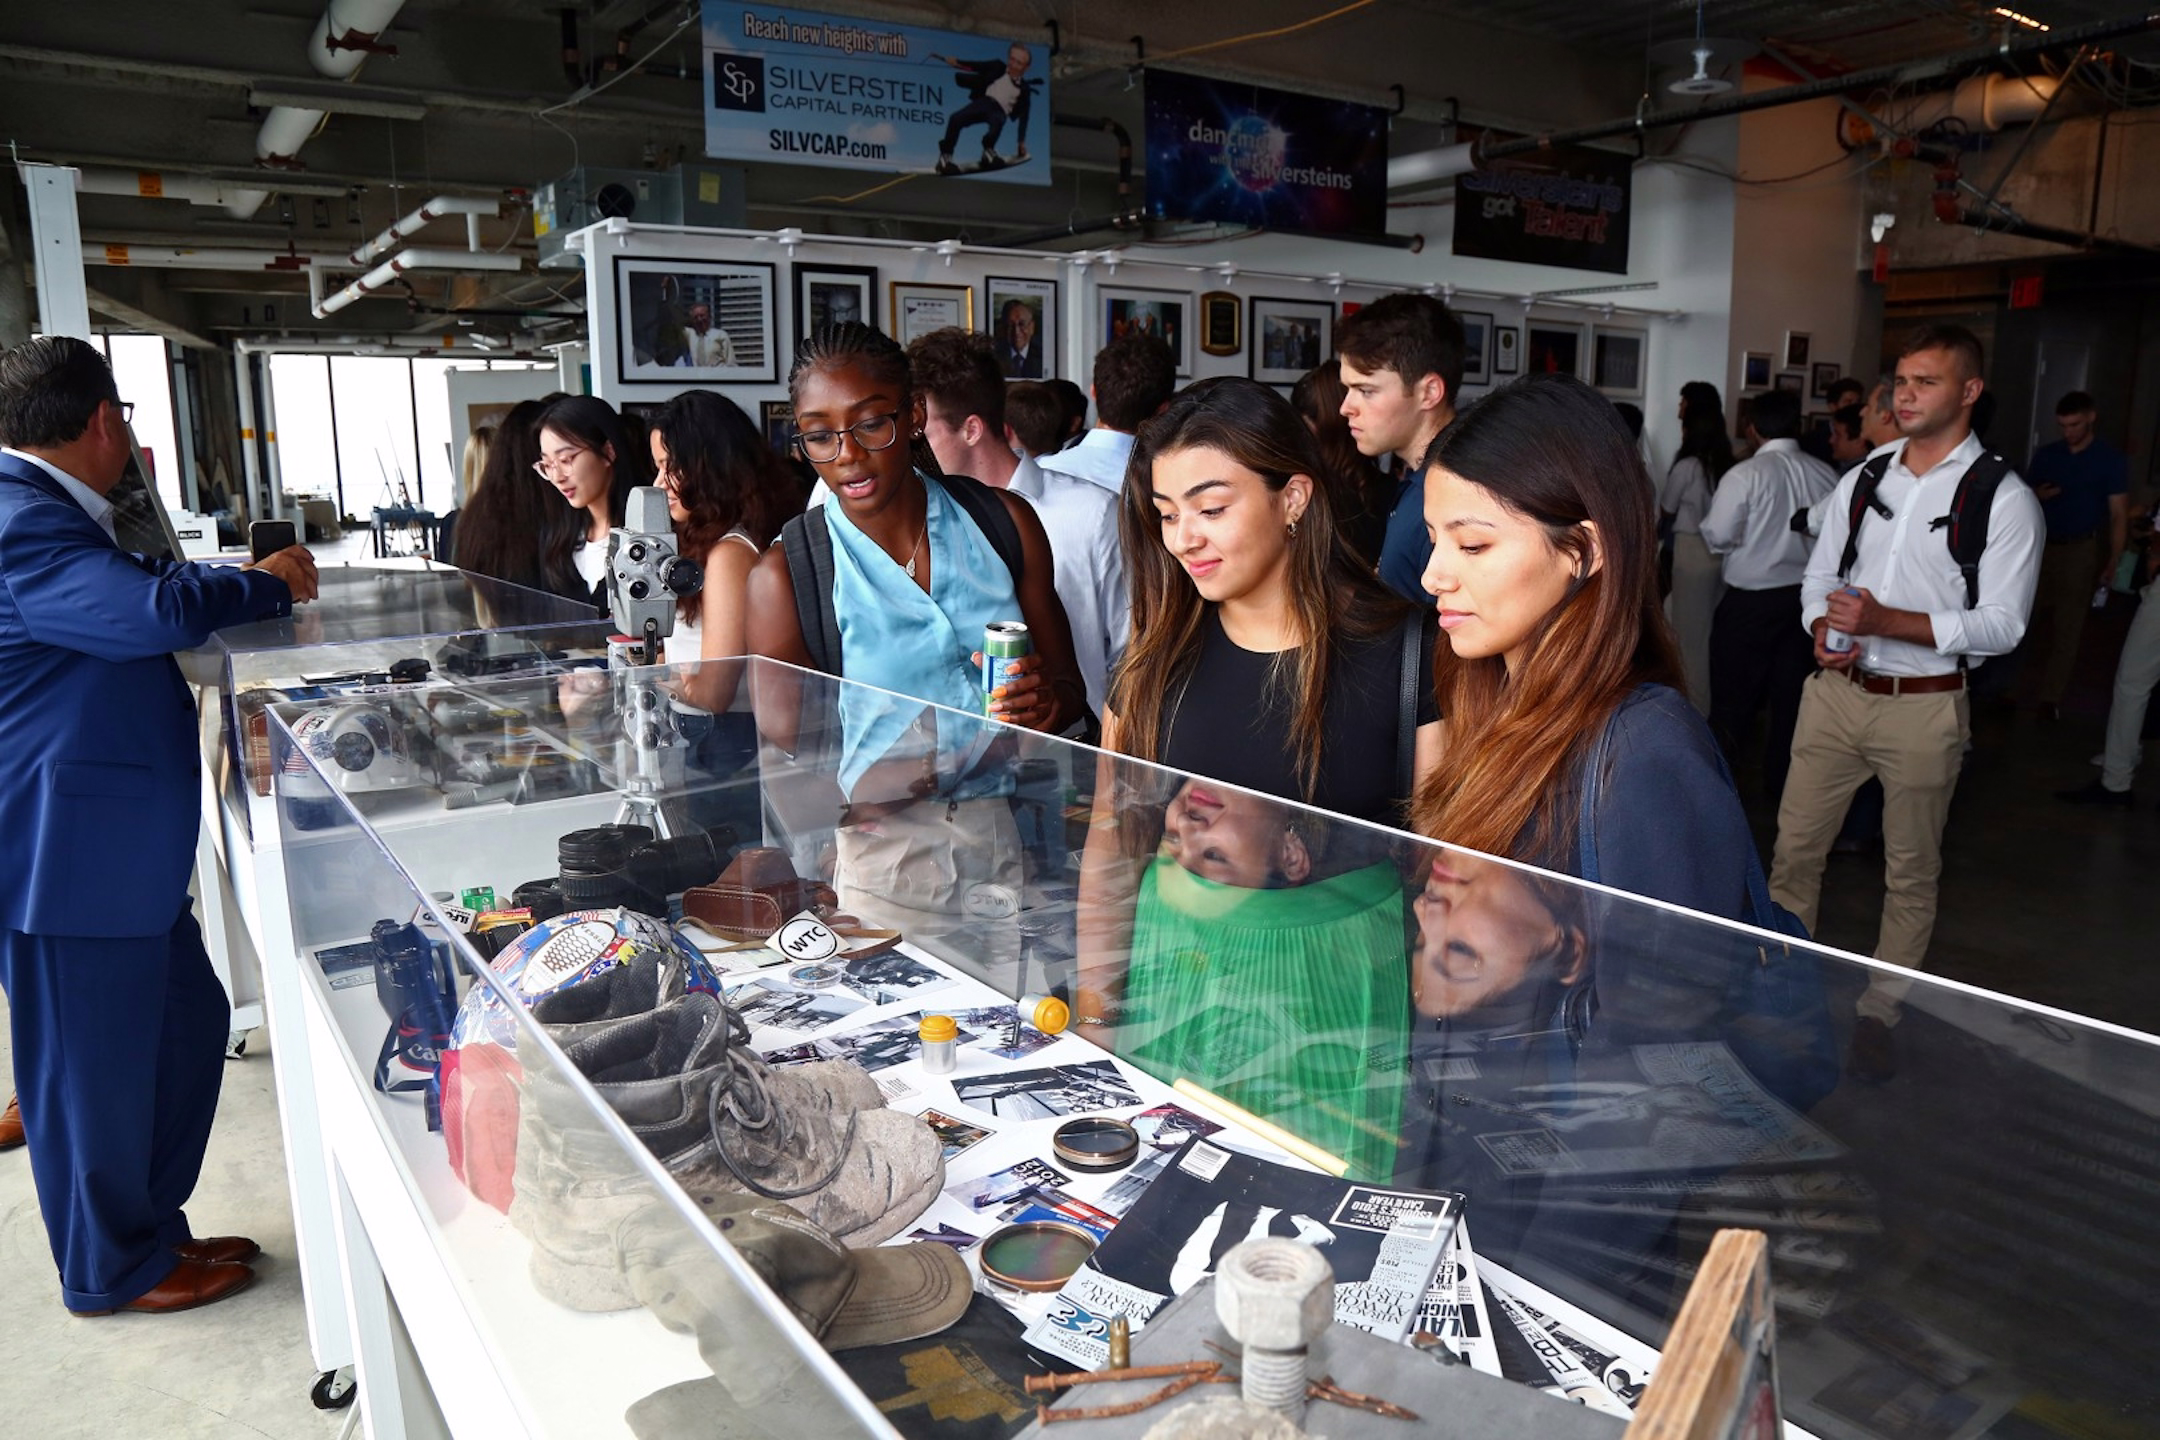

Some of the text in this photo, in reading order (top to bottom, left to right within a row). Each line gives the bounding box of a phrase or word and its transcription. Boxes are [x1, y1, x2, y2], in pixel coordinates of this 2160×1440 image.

[744, 13, 907, 57] Reach new heights with
[769, 65, 943, 107] SILVERSTEIN
[770, 94, 945, 125] CAPITAL PARTNERS
[770, 129, 887, 160] SILVCAP.com
[1251, 158, 1353, 190] silversteins
[1482, 196, 1517, 219] got
[1521, 198, 1609, 244] Talent
[788, 926, 827, 952] WTC
[1026, 1160, 1065, 1185] 2012
[1350, 1200, 1379, 1214] 2010
[1368, 1194, 1396, 1208] YEAR
[1379, 1205, 1433, 1221] ESQUIRE'S
[1403, 1199, 1425, 1210] CAR
[1080, 1279, 1153, 1315] NORMAL?
[1084, 1292, 1115, 1310] YOU
[1336, 1286, 1401, 1306] TRADE
[1354, 1282, 1414, 1299] CENTER
[1385, 1303, 1411, 1317] AT
